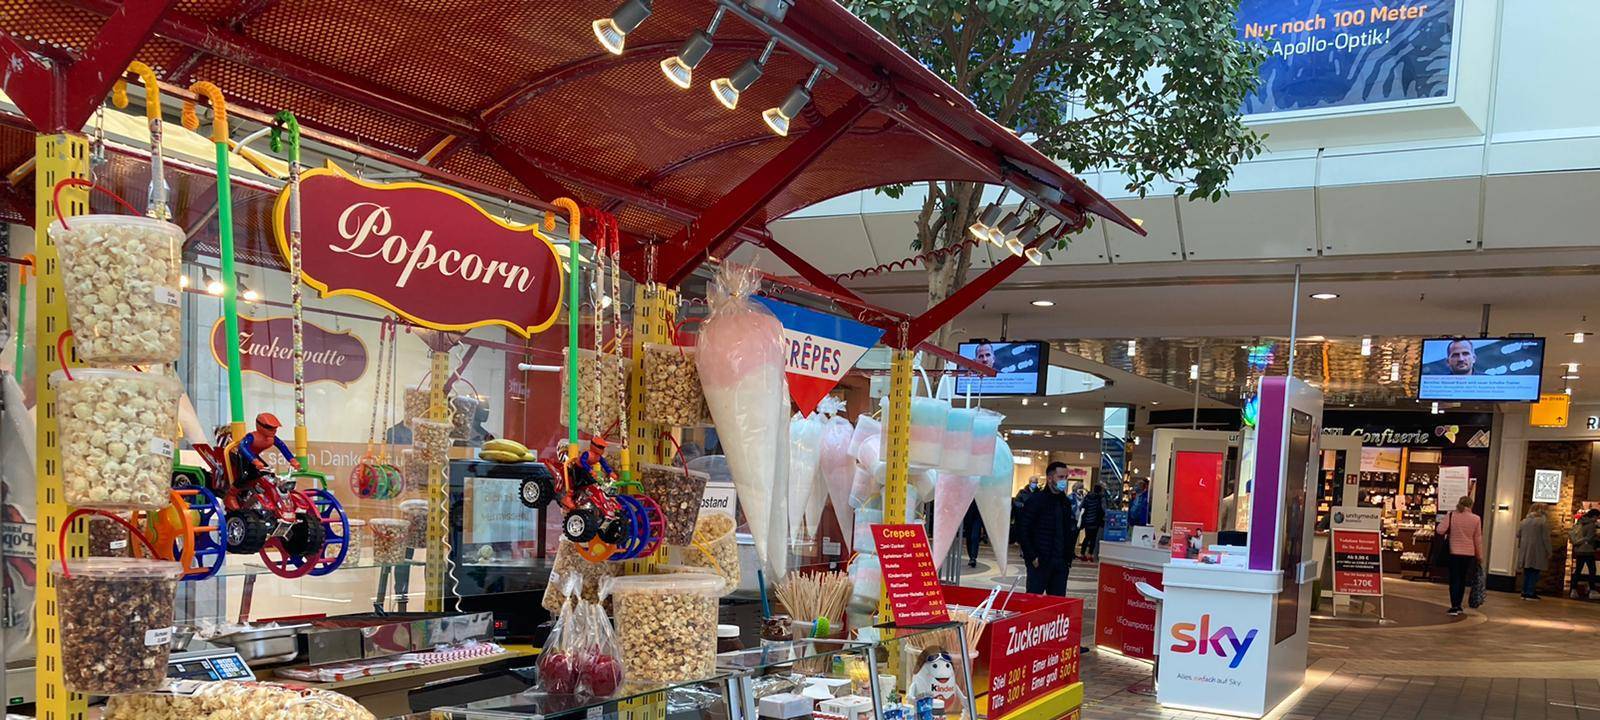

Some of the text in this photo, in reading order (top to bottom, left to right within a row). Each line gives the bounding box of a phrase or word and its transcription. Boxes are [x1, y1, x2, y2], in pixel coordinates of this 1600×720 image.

[1245, 4, 1428, 38] Nur noch 100 Meter
[1272, 28, 1391, 59] Apollo-Optik!
[328, 201, 536, 293] Popcorn
[1350, 427, 1429, 447] Confiserie
[1345, 512, 1379, 520] unitymedia
[882, 528, 916, 539] Crepes
[1006, 613, 1071, 656] Zuckerwatte
[1123, 642, 1145, 654] Formel 1
[1170, 614, 1259, 668] sky
[1032, 645, 1078, 673] Eimer klein 3,50 €
[992, 665, 1027, 691] Stiel 2,00 €
[1031, 660, 1078, 690] Eimer groß 5,00 €
[1177, 672, 1192, 681] Alles
[1228, 678, 1242, 687] Sky
[991, 682, 1026, 709] Tüte 3,00 €
